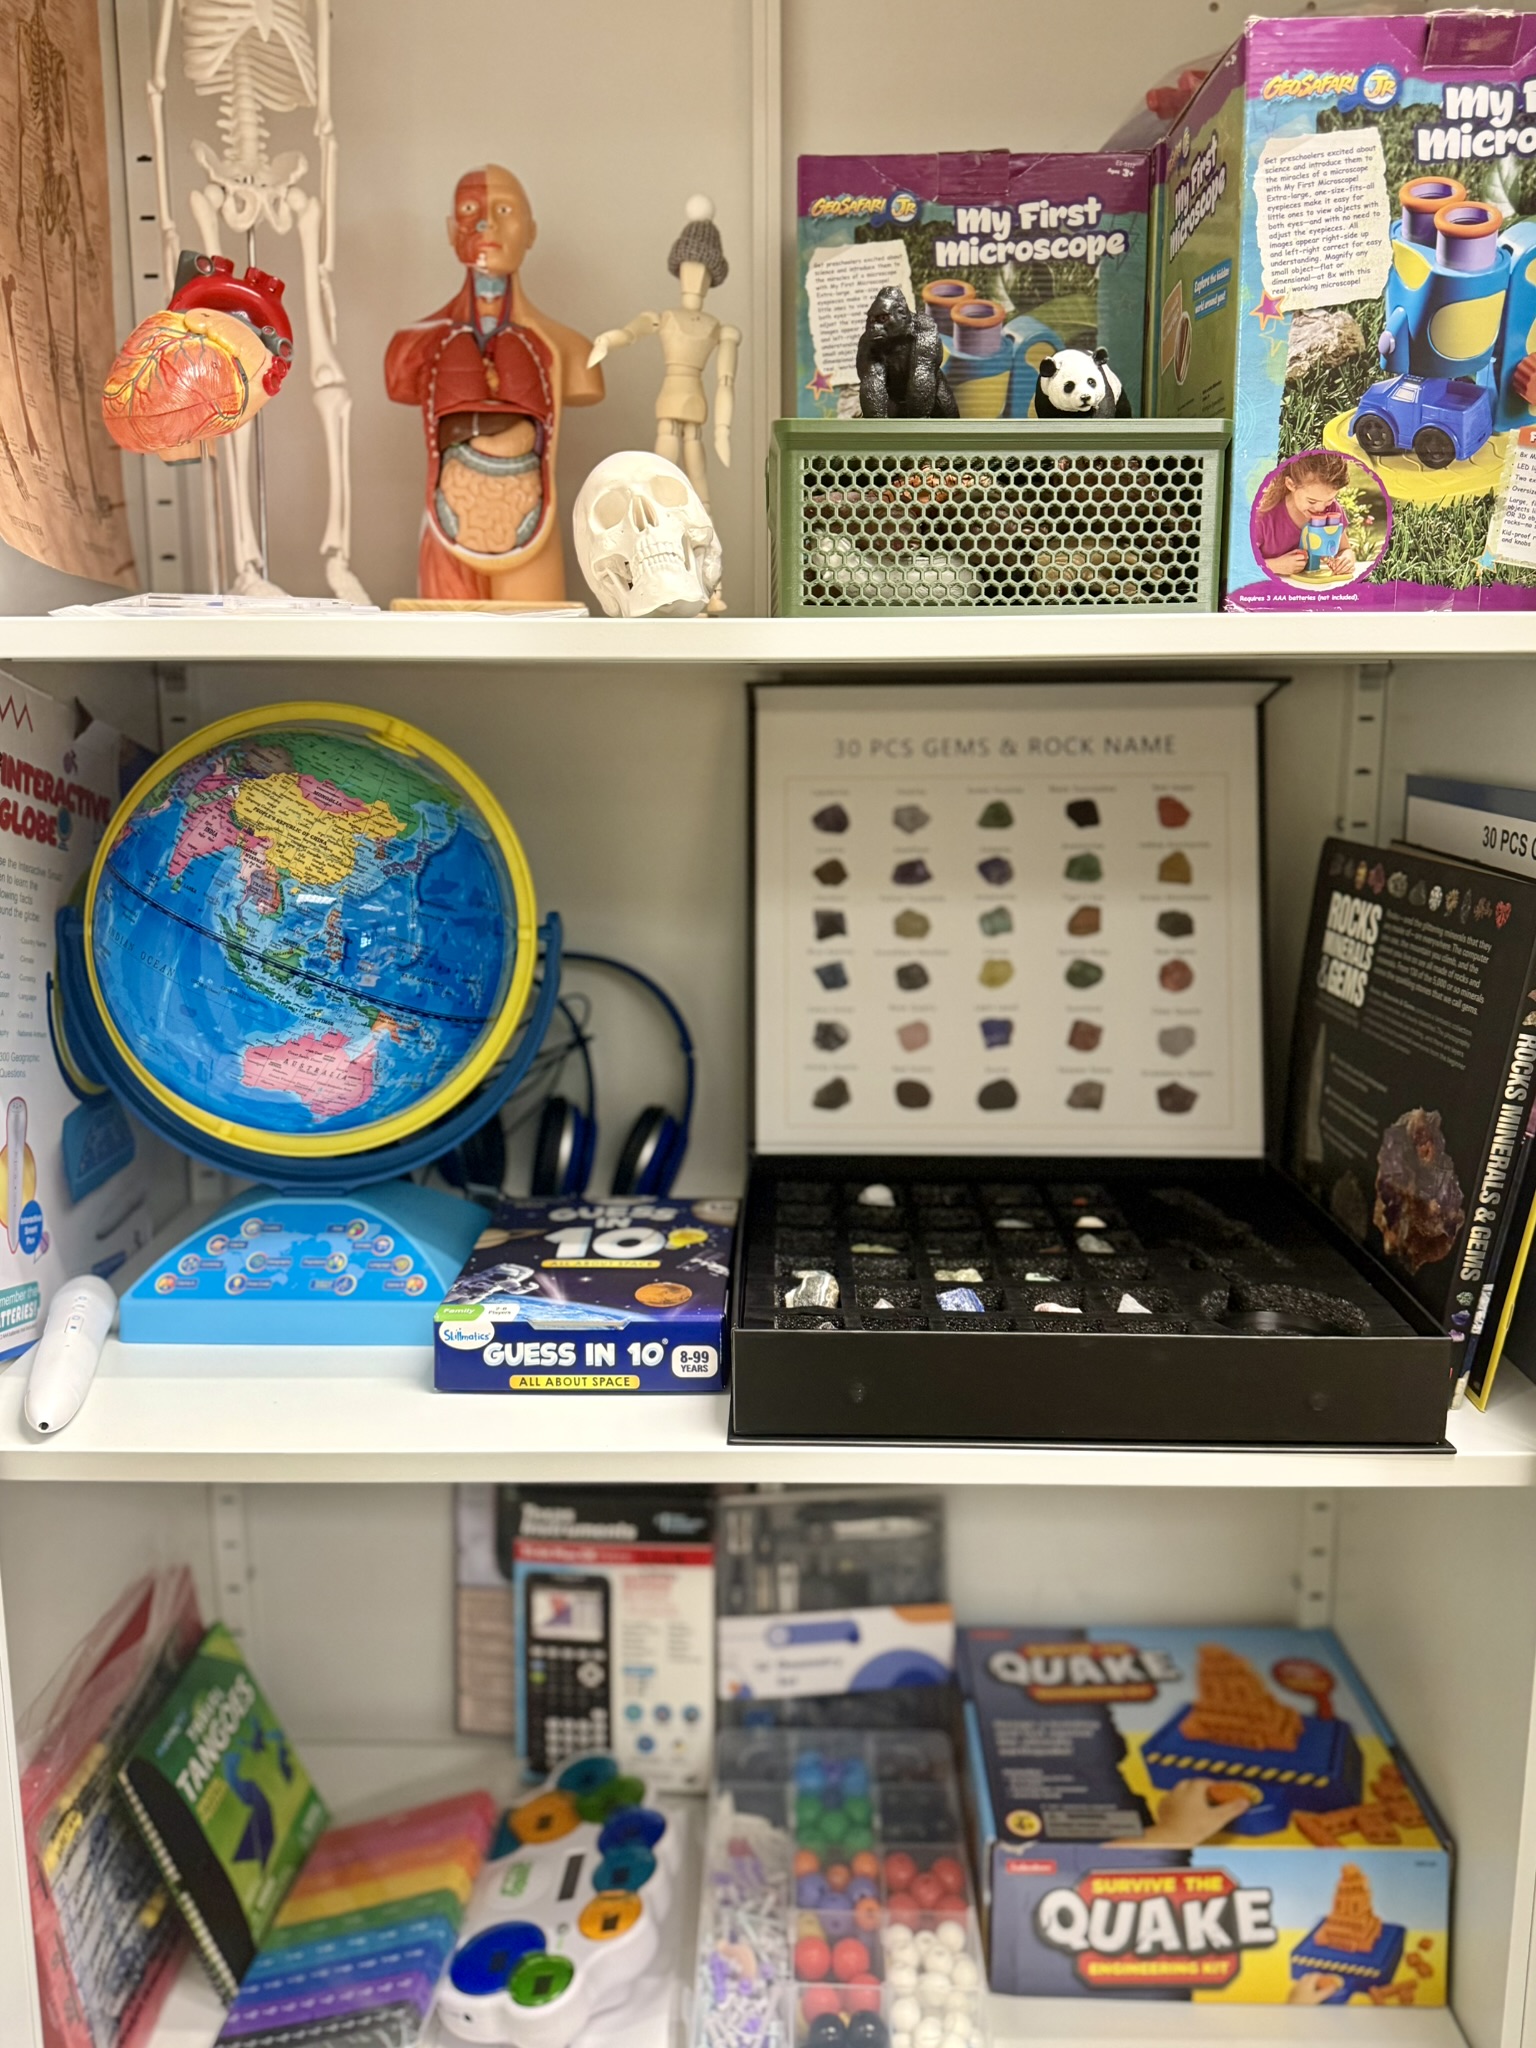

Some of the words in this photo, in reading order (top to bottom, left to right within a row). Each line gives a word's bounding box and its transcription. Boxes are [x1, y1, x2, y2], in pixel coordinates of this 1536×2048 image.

[1446, 85, 1514, 128] My
[1280, 153, 1324, 163] preschoolers
[1327, 147, 1354, 157] excited
[1356, 146, 1376, 154] about
[1309, 160, 1342, 168] introduce
[1330, 167, 1368, 175] microscope
[1175, 181, 1190, 217] My
[1191, 134, 1218, 196] First
[1318, 175, 1359, 186] Microscope!
[1267, 193, 1312, 202] Extra-large,
[1315, 183, 1374, 196] one-size-fits-all
[1268, 203, 1301, 212] eyepieces
[1334, 196, 1349, 204] easy
[1335, 204, 1361, 213] objects
[956, 207, 1011, 240] My
[1019, 197, 1102, 232] First
[1169, 166, 1226, 263] Microscope
[1287, 217, 1321, 228] eyes—and
[1269, 232, 1291, 240] adjust
[1309, 226, 1346, 234] eyepieces.
[1296, 238, 1319, 246] appear
[1322, 233, 1358, 243] right-side
[935, 230, 1128, 267] Microscope
[1285, 247, 1320, 256] left-right
[1271, 256, 1321, 267] understanding.
[1325, 252, 1353, 261] Magnify
[1291, 264, 1333, 274] object—flat
[1272, 273, 1324, 285] dimensional—at
[1272, 287, 1288, 295] real,
[1292, 283, 1318, 292] working
[1321, 278, 1361, 288] microscope!
[1517, 463, 1530, 471] LED
[1507, 504, 1530, 513] objects
[1509, 497, 1528, 506] Large,
[1502, 529, 1531, 539] Kid-proof
[1515, 538, 1531, 547] knobs
[1240, 595, 1264, 603] Requires
[832, 737, 862, 760] 30
[869, 737, 915, 759] PCS
[922, 737, 991, 758] GEMS
[999, 736, 1019, 758] &
[1027, 735, 1095, 757] ROCK
[1103, 734, 1176, 756] NAME
[0, 798, 57, 847] GLOBE
[1483, 825, 1497, 849] 30
[1500, 829, 1528, 857] PCS
[1326, 890, 1383, 944] ROCKS
[108, 926, 134, 951] INDIAN
[140, 952, 176, 977] OCEAN
[1326, 959, 1368, 1008] GEMS
[283, 1058, 348, 1081] AUSTRALIA
[1504, 1032, 1536, 1102] ROCKS
[1478, 1103, 1524, 1205] MINERALS
[548, 1206, 680, 1222] GUESS
[1473, 1206, 1497, 1224] &
[594, 1217, 632, 1229] IN
[544, 1226, 666, 1259] 10
[1459, 1225, 1492, 1282] GEMS
[444, 1327, 490, 1343] Skillmatics
[483, 1342, 577, 1367] GUESS
[585, 1343, 616, 1367] IN
[680, 1351, 709, 1364] 8-99
[681, 1364, 708, 1373] YEARS
[519, 1377, 540, 1387] ALL
[546, 1377, 587, 1387] ABOUT
[592, 1377, 631, 1387] SPACE
[988, 1650, 1183, 1686] QUAKE
[1092, 1877, 1177, 1893] SURVIVE
[1184, 1876, 1223, 1892] THE
[1039, 1888, 1278, 1953] QUAKE
[1088, 1963, 1199, 1976] ENGINEERING
[1201, 1961, 1231, 1975] KIT
